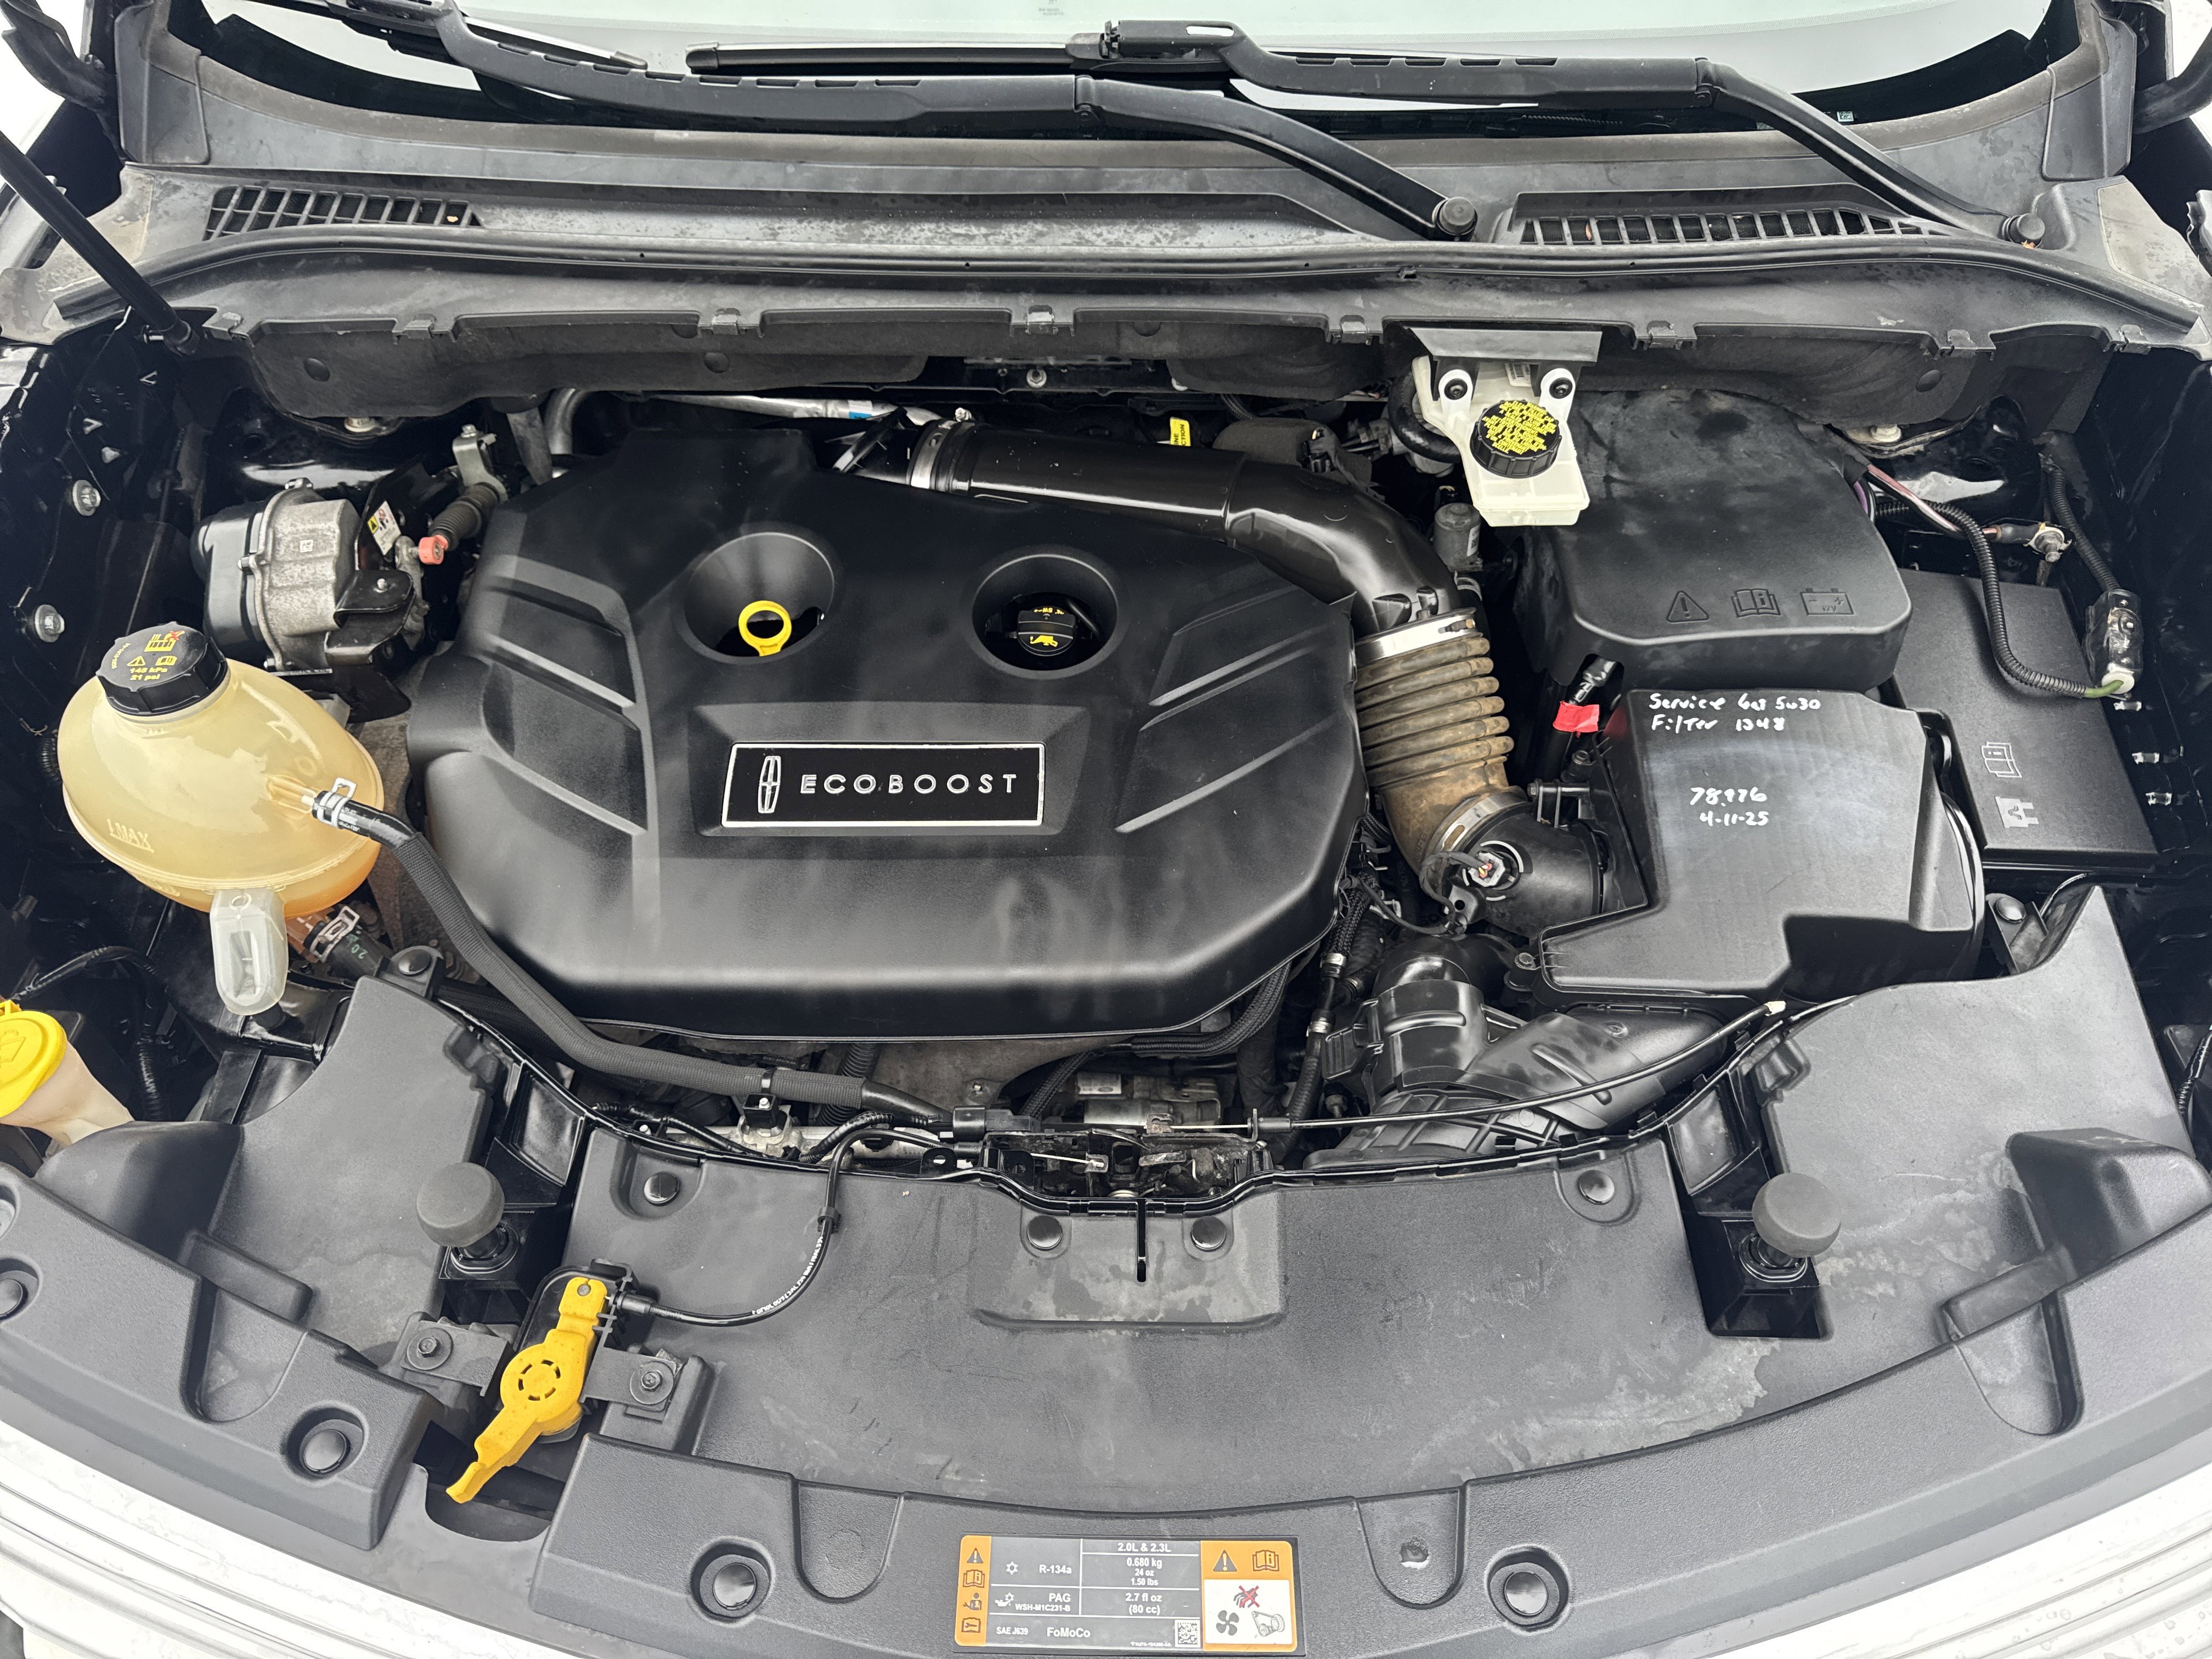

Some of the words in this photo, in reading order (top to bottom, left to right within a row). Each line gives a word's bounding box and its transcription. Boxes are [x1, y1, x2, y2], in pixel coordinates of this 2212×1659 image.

[1649, 693, 1726, 710] Service
[800, 774, 1017, 794] ECOBOOST
[1118, 1542, 1138, 1551] 2.0L
[1141, 1543, 1148, 1551] &
[1150, 1543, 1171, 1552] 2.3L
[1126, 1558, 1149, 1566] 0.680
[1152, 1558, 1162, 1569] kg
[1039, 1564, 1072, 1575] R-134a
[1049, 1593, 1071, 1602] PAG
[1125, 1593, 1139, 1601] 2.7
[1142, 1593, 1148, 1601] fl
[1128, 1604, 1143, 1615] (80
[1146, 1605, 1160, 1616] cc)
[996, 1626, 1011, 1634] SAE
[1012, 1627, 1028, 1635] J639
[1047, 1627, 1090, 1638] FoMoCo
